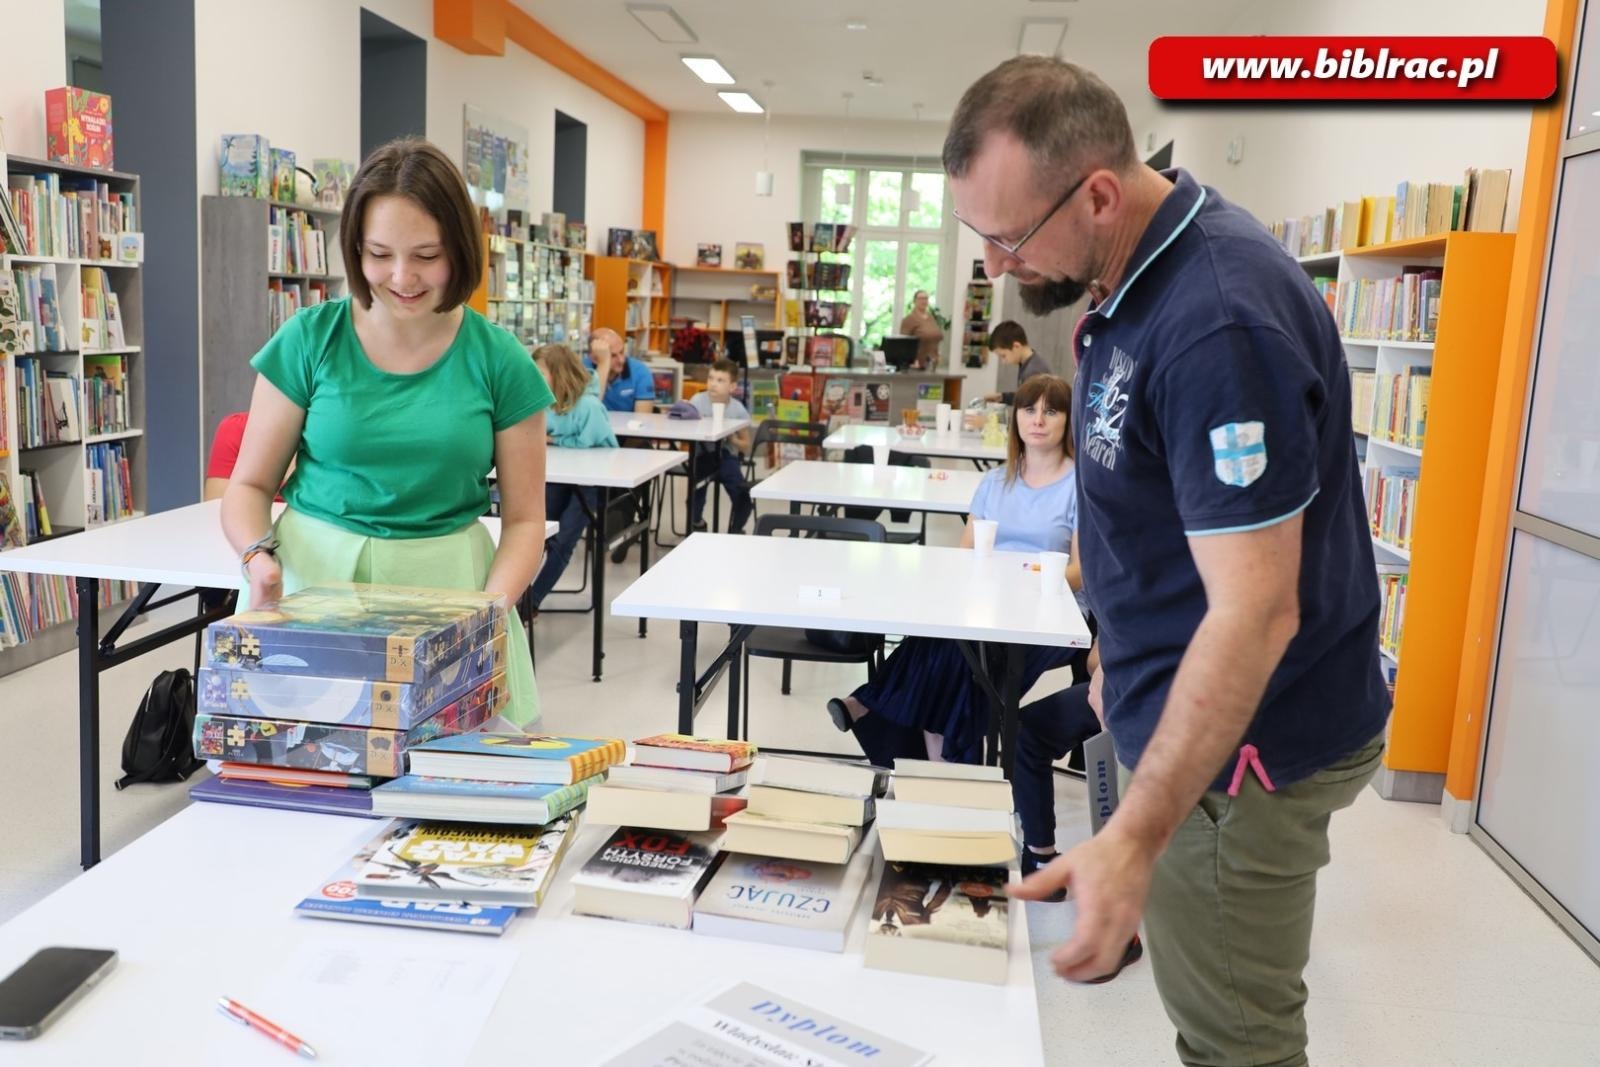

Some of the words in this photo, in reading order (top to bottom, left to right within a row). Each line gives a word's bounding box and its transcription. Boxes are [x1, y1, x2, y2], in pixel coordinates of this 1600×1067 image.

[421, 841, 524, 855] WARS
[613, 830, 693, 857] FOX
[407, 847, 522, 863] STAR
[600, 855, 676, 870] FREDERICK
[603, 848, 694, 866] FORSYTH
[727, 884, 831, 914] CZUJĄC
[749, 1000, 881, 1058] Dyplom
